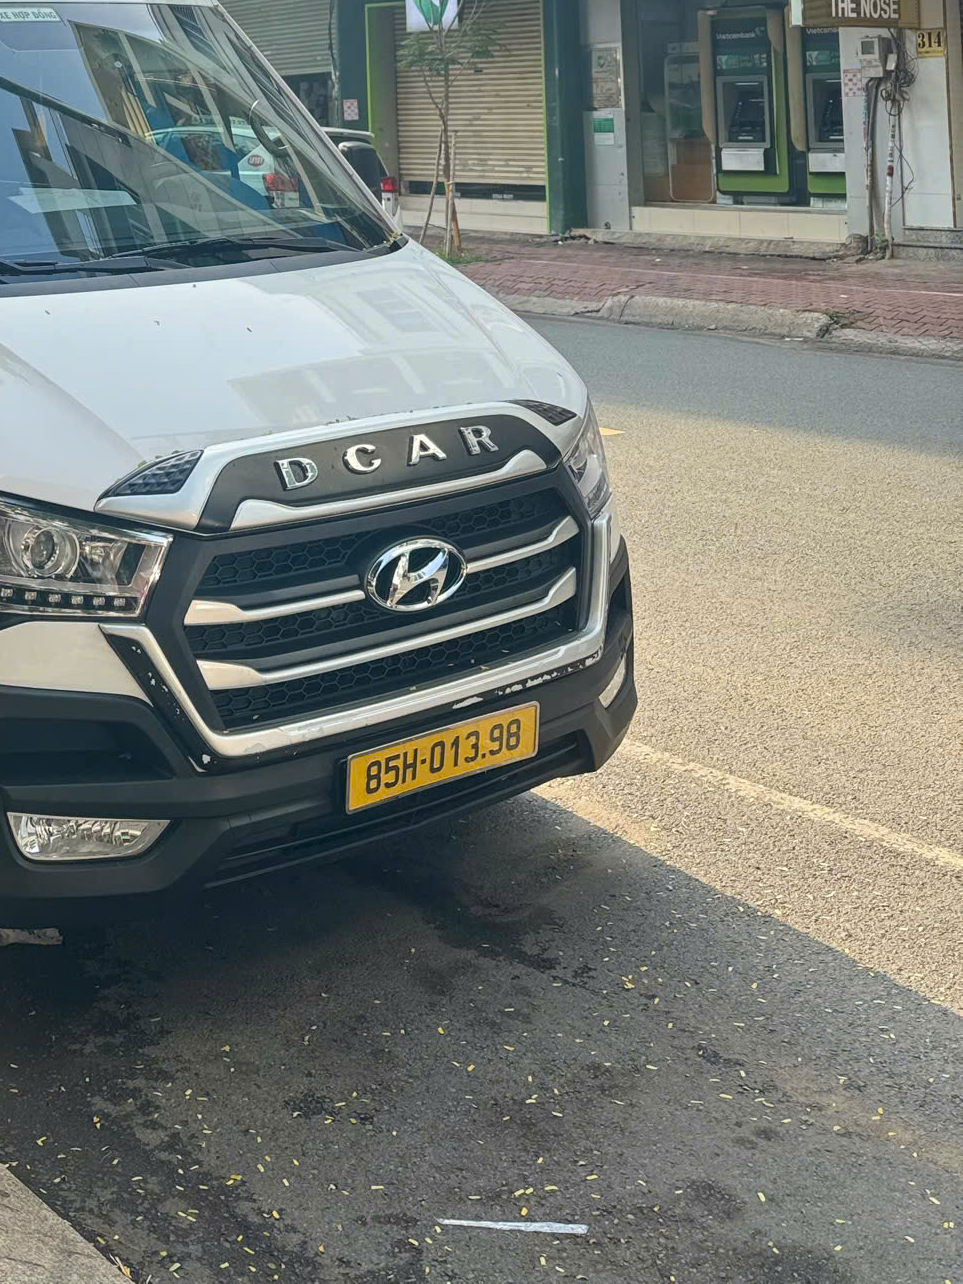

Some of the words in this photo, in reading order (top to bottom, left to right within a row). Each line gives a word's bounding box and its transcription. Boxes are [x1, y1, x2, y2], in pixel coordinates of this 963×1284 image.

[715, 31, 757, 40] Vietcombank
[918, 31, 942, 49] 314
[273, 425, 500, 491] DCAR
[366, 718, 521, 794] 85H-013.98
